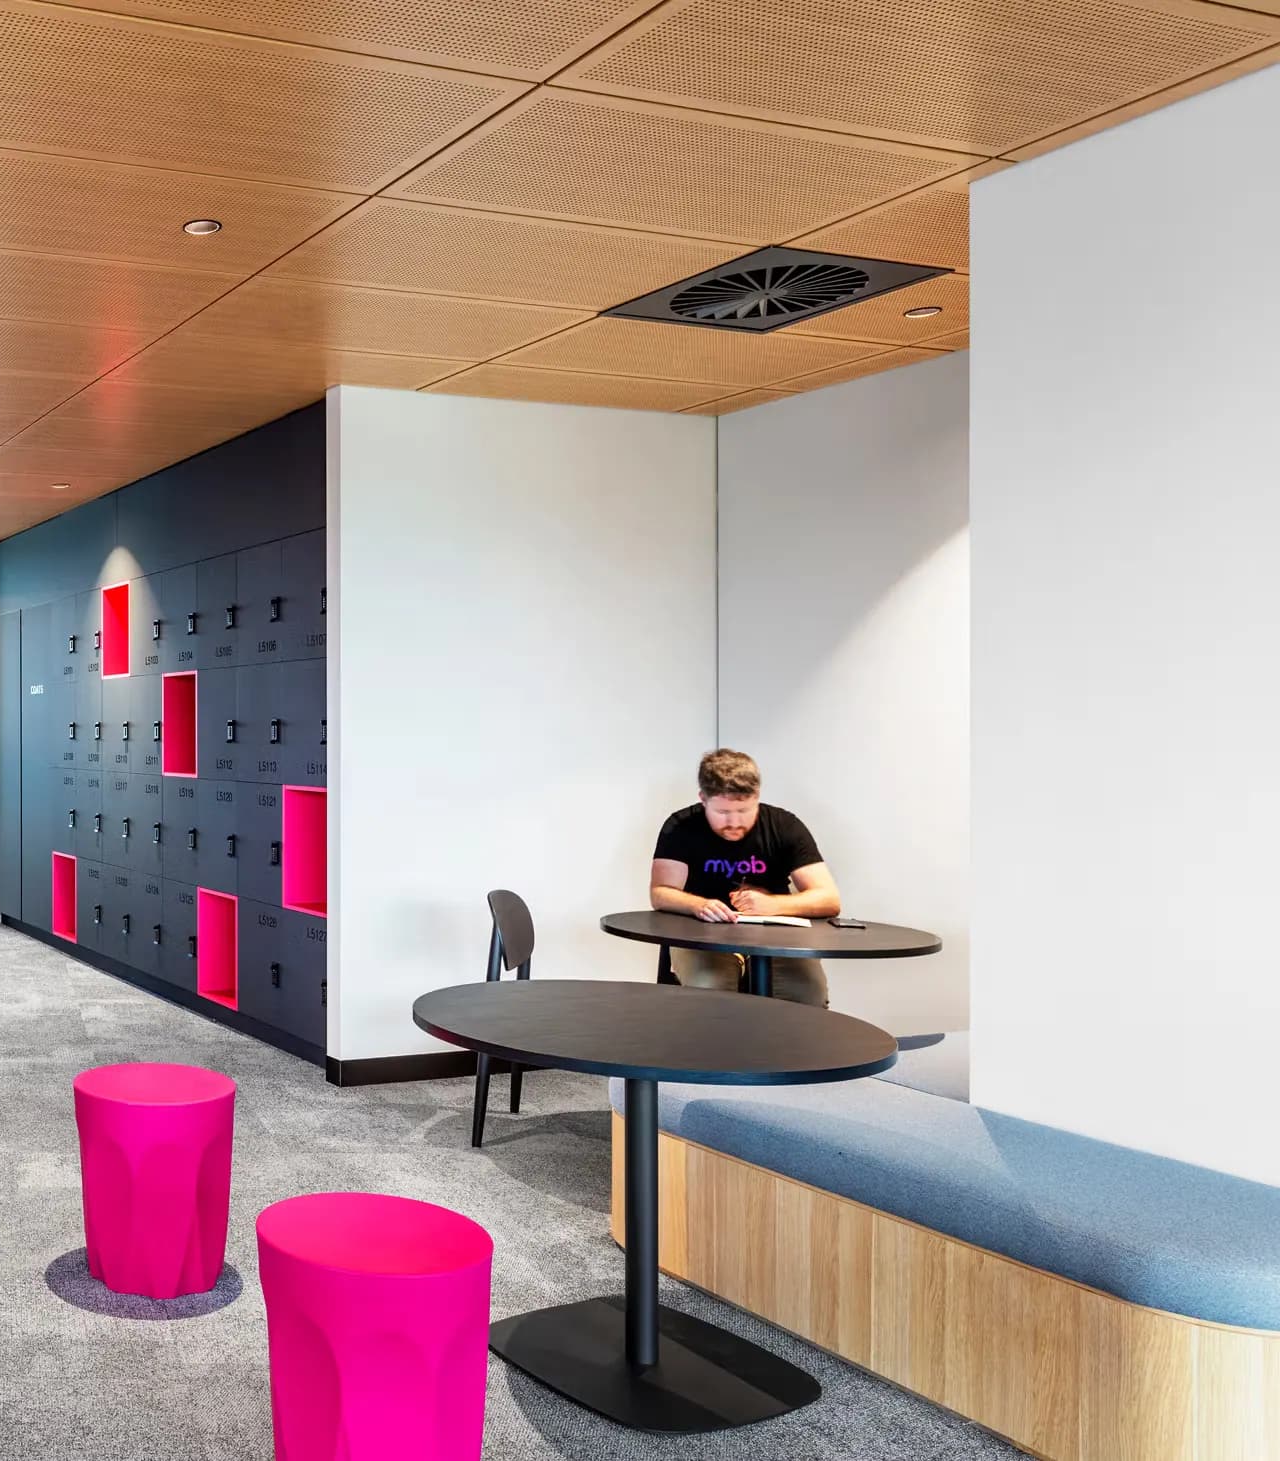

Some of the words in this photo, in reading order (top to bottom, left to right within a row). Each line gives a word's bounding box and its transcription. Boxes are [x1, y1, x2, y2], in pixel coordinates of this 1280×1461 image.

[258, 640, 277, 653] L5106
[178, 650, 193, 662] L5104
[30, 685, 44, 695] COATS
[216, 759, 233, 770] L5112
[258, 761, 277, 772] L5113
[216, 791, 233, 802] L5120
[258, 794, 277, 807] L5121
[704, 855, 767, 878] myob
